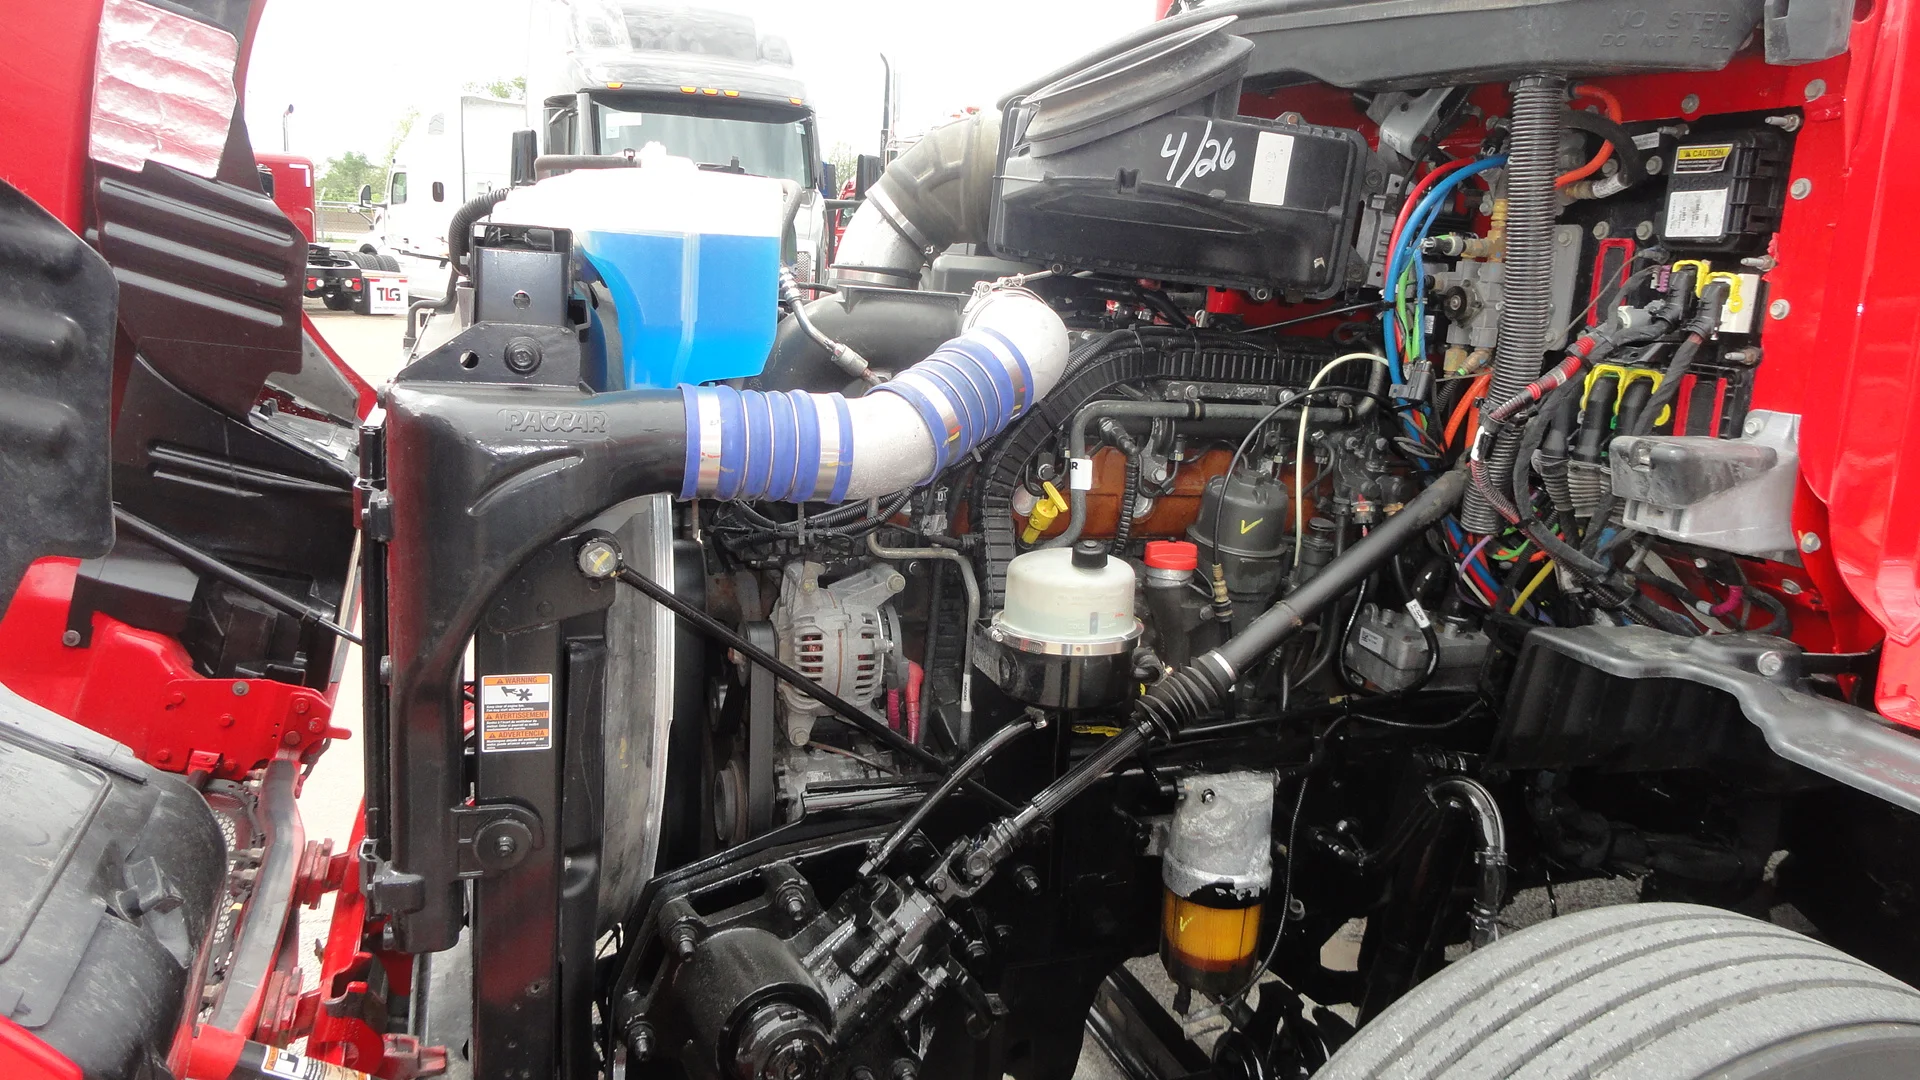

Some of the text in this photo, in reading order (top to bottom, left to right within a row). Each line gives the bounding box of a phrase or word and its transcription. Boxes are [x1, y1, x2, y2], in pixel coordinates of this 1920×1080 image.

[1666, 10, 1730, 31] STEP
[1160, 120, 1237, 189] 4/26
[1692, 149, 1724, 158] CAUTION
[376, 287, 401, 301] TLG
[502, 409, 607, 433] PACCAR
[505, 676, 538, 684] WARNING
[494, 711, 548, 720] AVERTISSEMENT
[498, 730, 545, 738] ADVERTENCIA
